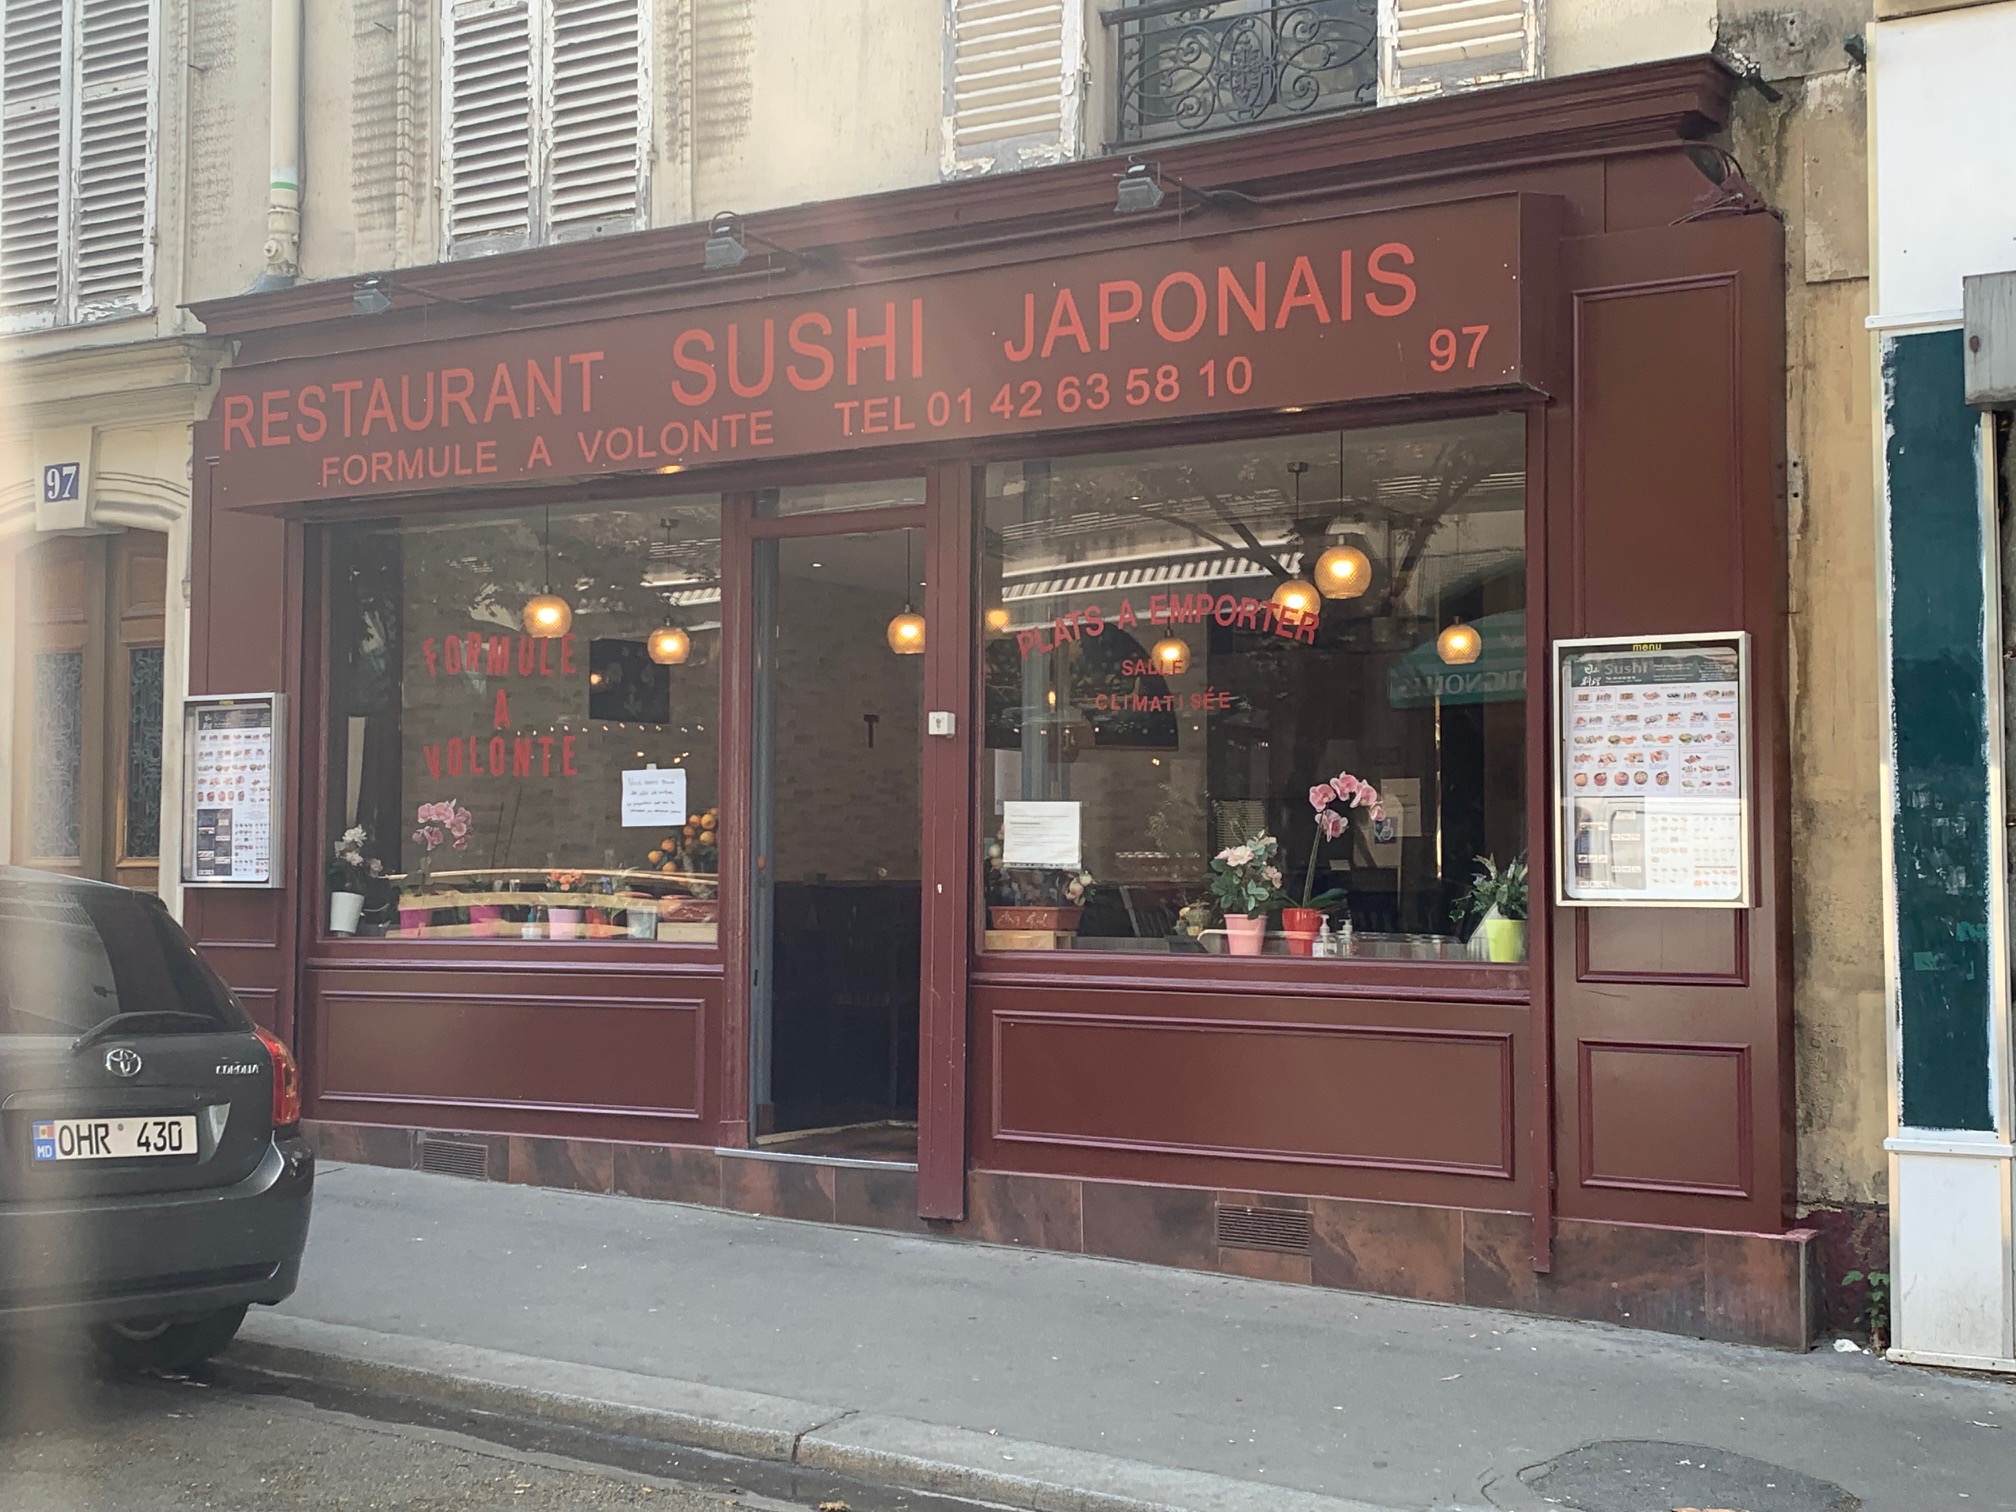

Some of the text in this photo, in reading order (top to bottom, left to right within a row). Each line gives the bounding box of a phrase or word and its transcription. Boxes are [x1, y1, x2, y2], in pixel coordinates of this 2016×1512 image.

[224, 242, 1417, 451] RESTAURANT SUSHI JAPONAIS
[1429, 325, 1491, 373] 97
[322, 355, 1253, 488] FORMULE A VOLONTE TEL 01 42 63 58 10
[46, 465, 77, 500] 97
[1016, 593, 1320, 661] PLATS A EMPORTER
[1632, 642, 1662, 652] menu
[422, 632, 577, 678] FORMULE
[1121, 659, 1184, 677] SALLE
[1604, 660, 1649, 676] Sushi
[493, 688, 512, 728] A
[422, 735, 578, 781] VOLONTE
[37, 1120, 183, 1158] MD OHR 430
